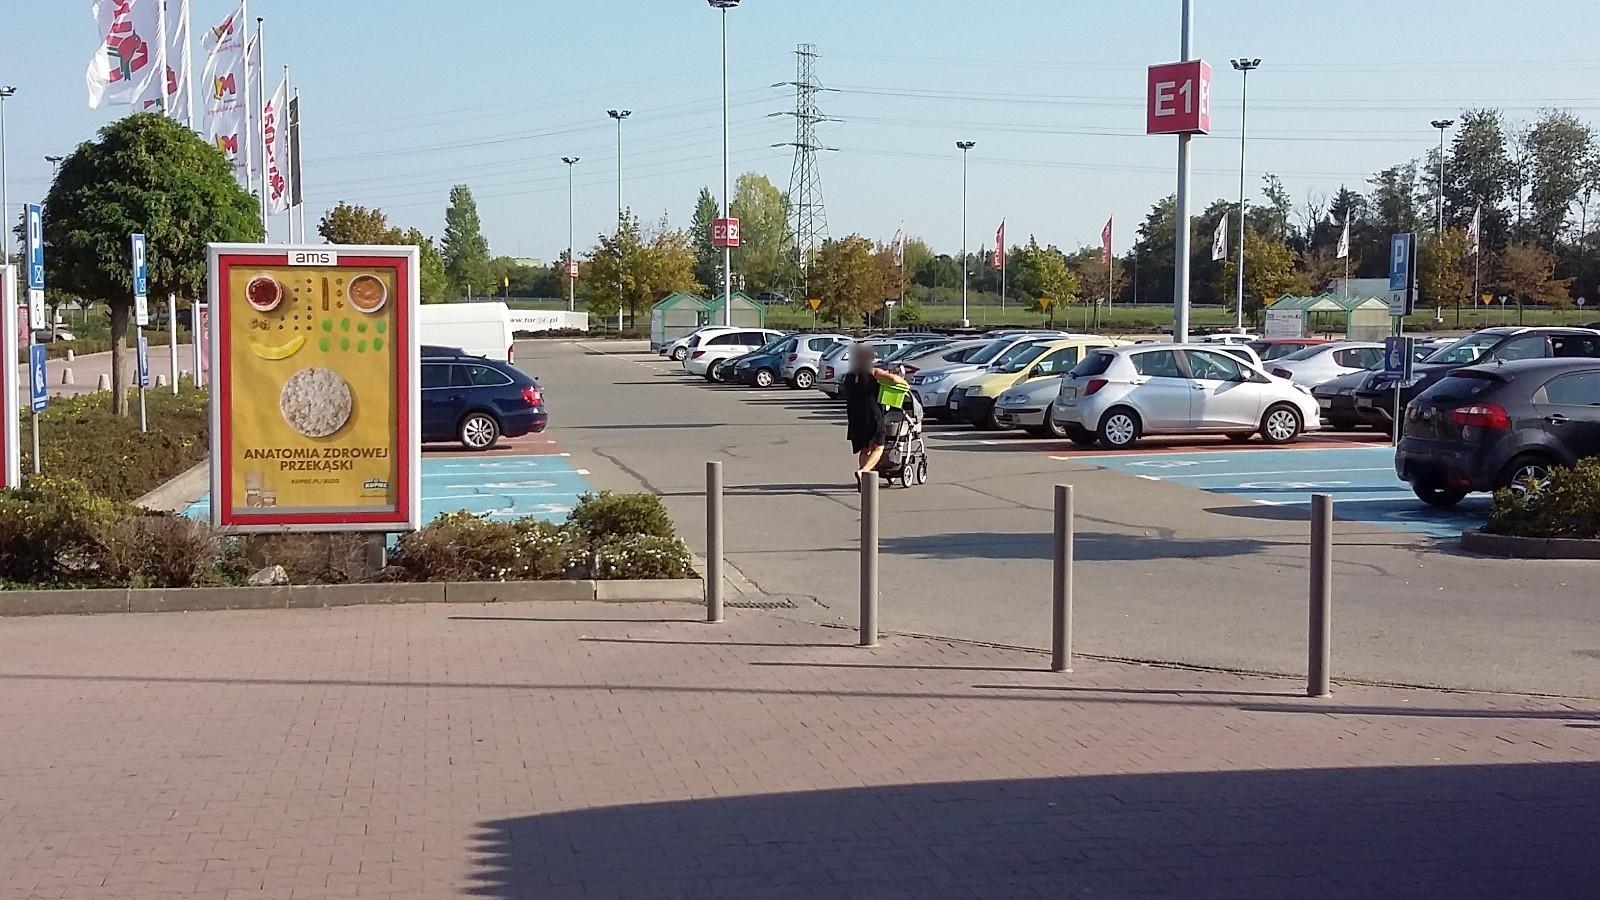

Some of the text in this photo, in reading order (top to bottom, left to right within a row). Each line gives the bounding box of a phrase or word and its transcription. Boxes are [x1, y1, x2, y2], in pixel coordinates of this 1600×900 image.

[1155, 79, 1192, 117] E1
[31, 211, 40, 263] P
[714, 225, 727, 240] E2
[728, 224, 738, 240] E2
[135, 240, 143, 278] P
[295, 252, 330, 264] ams
[1394, 239, 1405, 273] P
[244, 447, 388, 460] ANATOMIA ZDROWEJ
[280, 460, 353, 472] PRZEKĄSKI
[364, 481, 388, 489] KUPIEC
